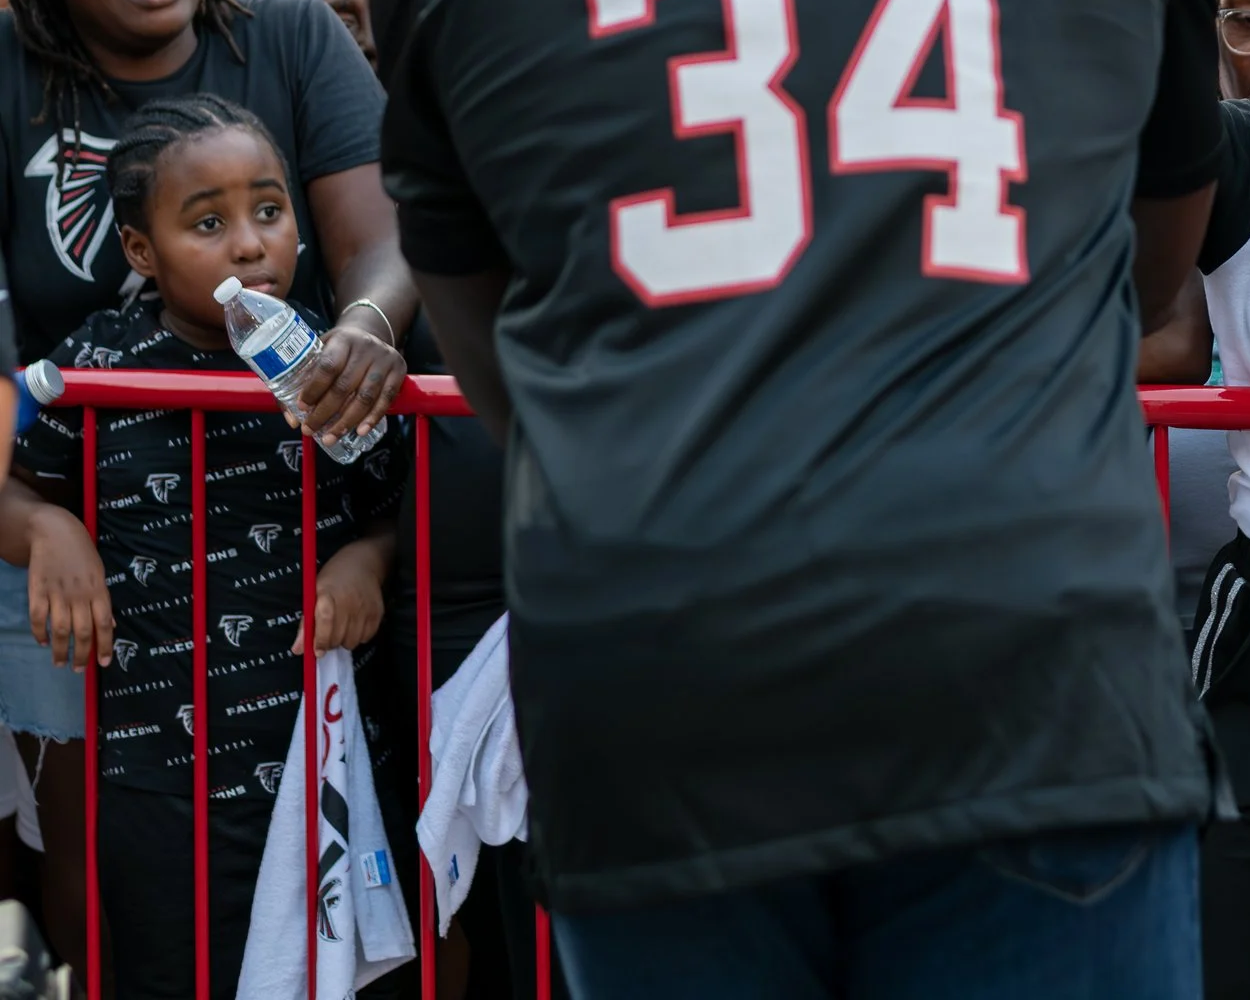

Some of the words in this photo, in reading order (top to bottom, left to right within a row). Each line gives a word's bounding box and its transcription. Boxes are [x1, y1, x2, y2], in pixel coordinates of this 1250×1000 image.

[110, 409, 173, 431] FALCON
[205, 461, 268, 484] ALCONS
[226, 691, 299, 716] FALCONS
[106, 724, 162, 741] FALCONS
